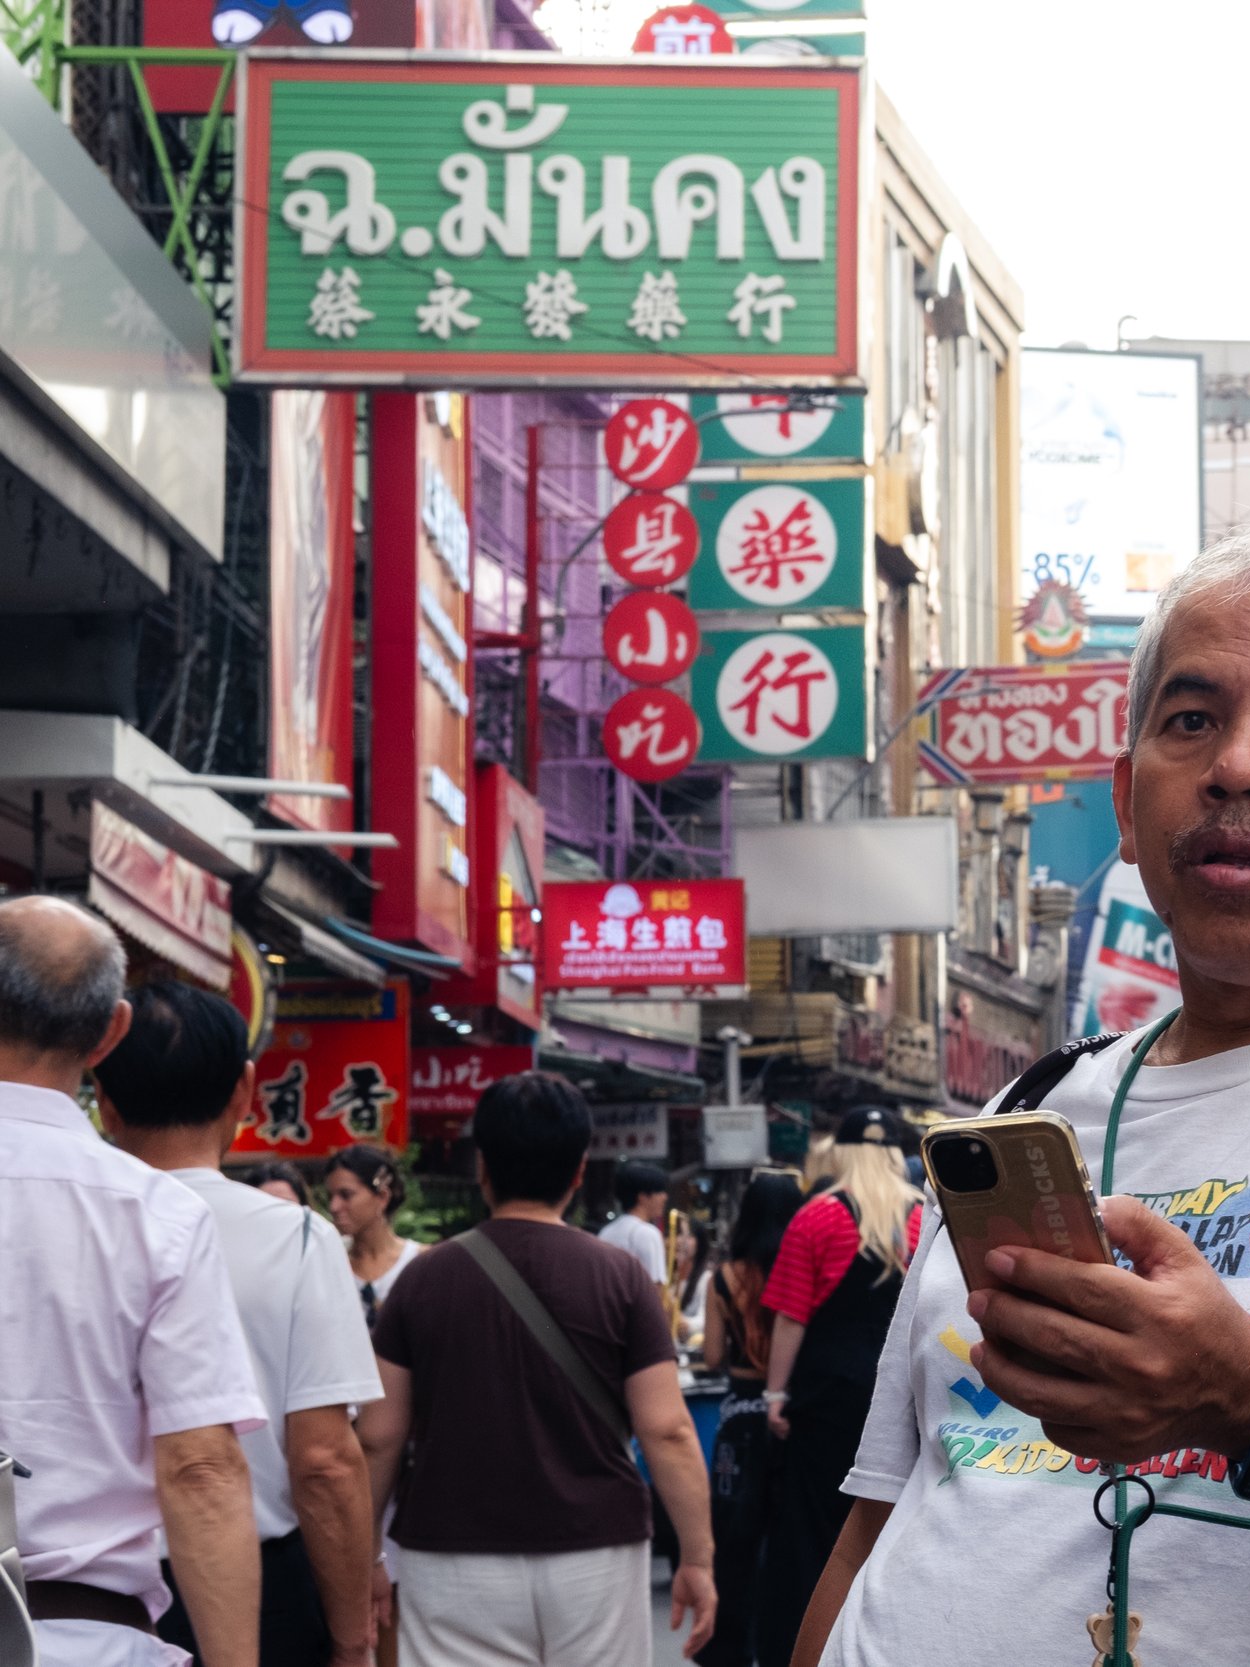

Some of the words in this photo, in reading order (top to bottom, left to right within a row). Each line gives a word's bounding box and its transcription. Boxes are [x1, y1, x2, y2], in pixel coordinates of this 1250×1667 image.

[280, 84, 826, 260] ฉ.มั่นคง
[307, 267, 796, 343] 蔡永發藥行
[616, 407, 690, 765] 沙县小吃
[945, 678, 1132, 765] ทองใ
